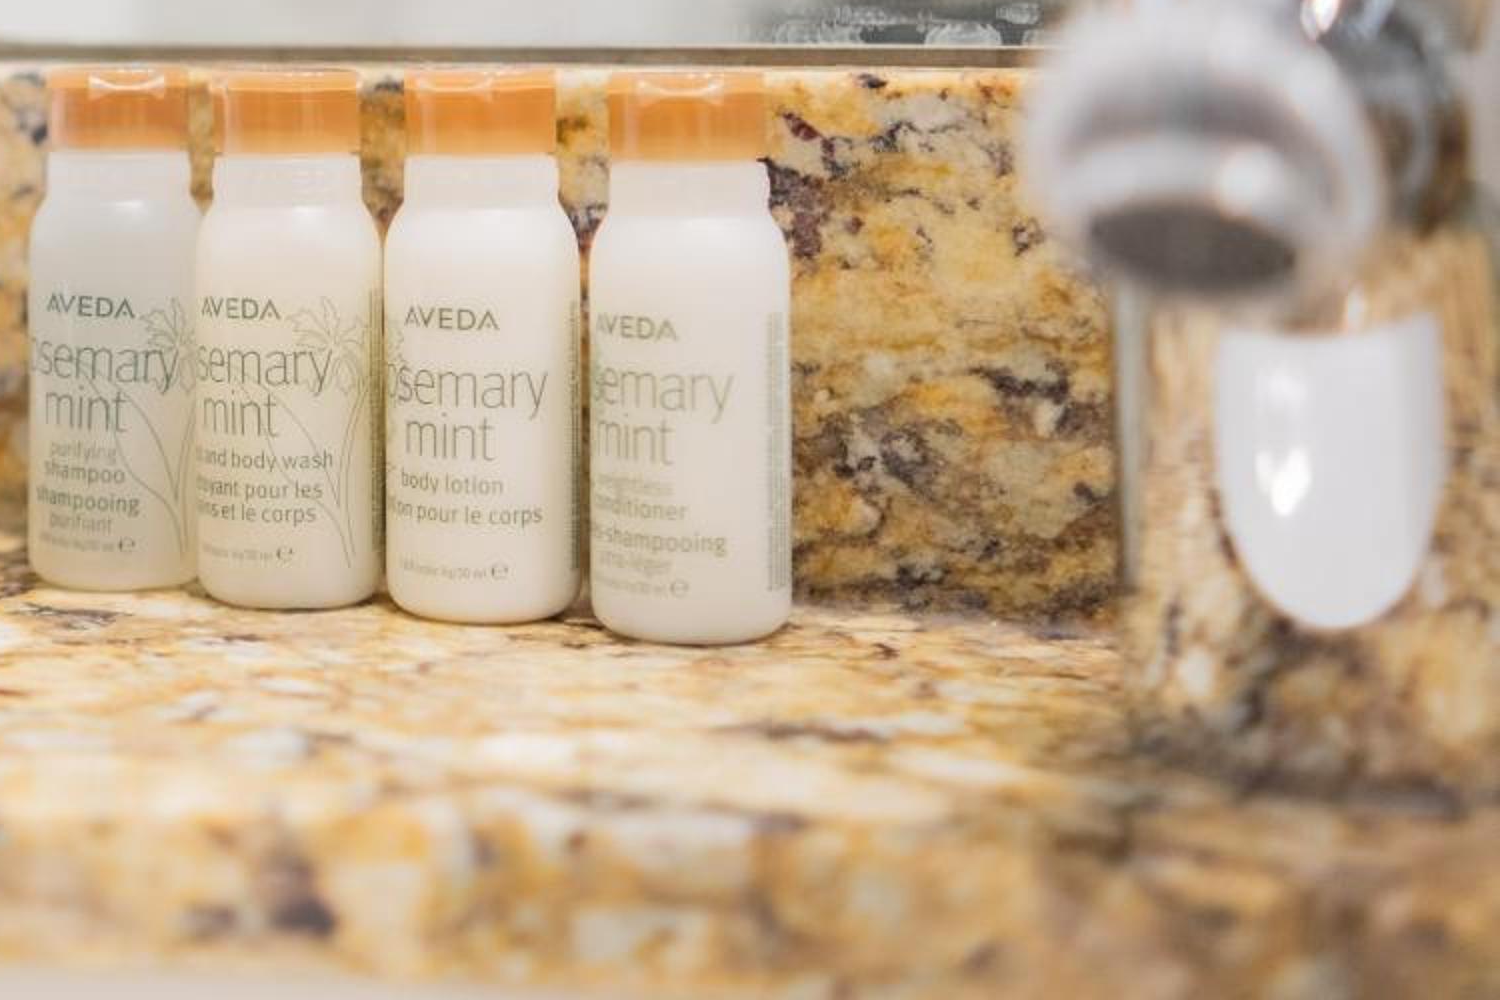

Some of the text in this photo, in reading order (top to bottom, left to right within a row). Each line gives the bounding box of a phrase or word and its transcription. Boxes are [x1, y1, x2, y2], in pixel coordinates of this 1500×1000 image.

[46, 293, 136, 319] AVEDA
[201, 297, 281, 321] AVEDA
[403, 306, 500, 331] AVEDA
[596, 314, 678, 342] AVEDA
[31, 337, 179, 396] semary
[45, 385, 128, 433] mint
[203, 389, 279, 438] mint
[406, 411, 498, 461] mint
[597, 412, 675, 465] mint
[44, 458, 126, 488] shampoo
[231, 449, 277, 472] body
[282, 449, 333, 469] wash
[245, 483, 289, 503] pour
[295, 480, 324, 500] les
[401, 467, 504, 496] body lotion
[36, 485, 141, 518] shampooing
[596, 493, 689, 521] ditioner
[261, 507, 317, 528] corps
[416, 503, 458, 524] pour
[488, 507, 544, 530] corps
